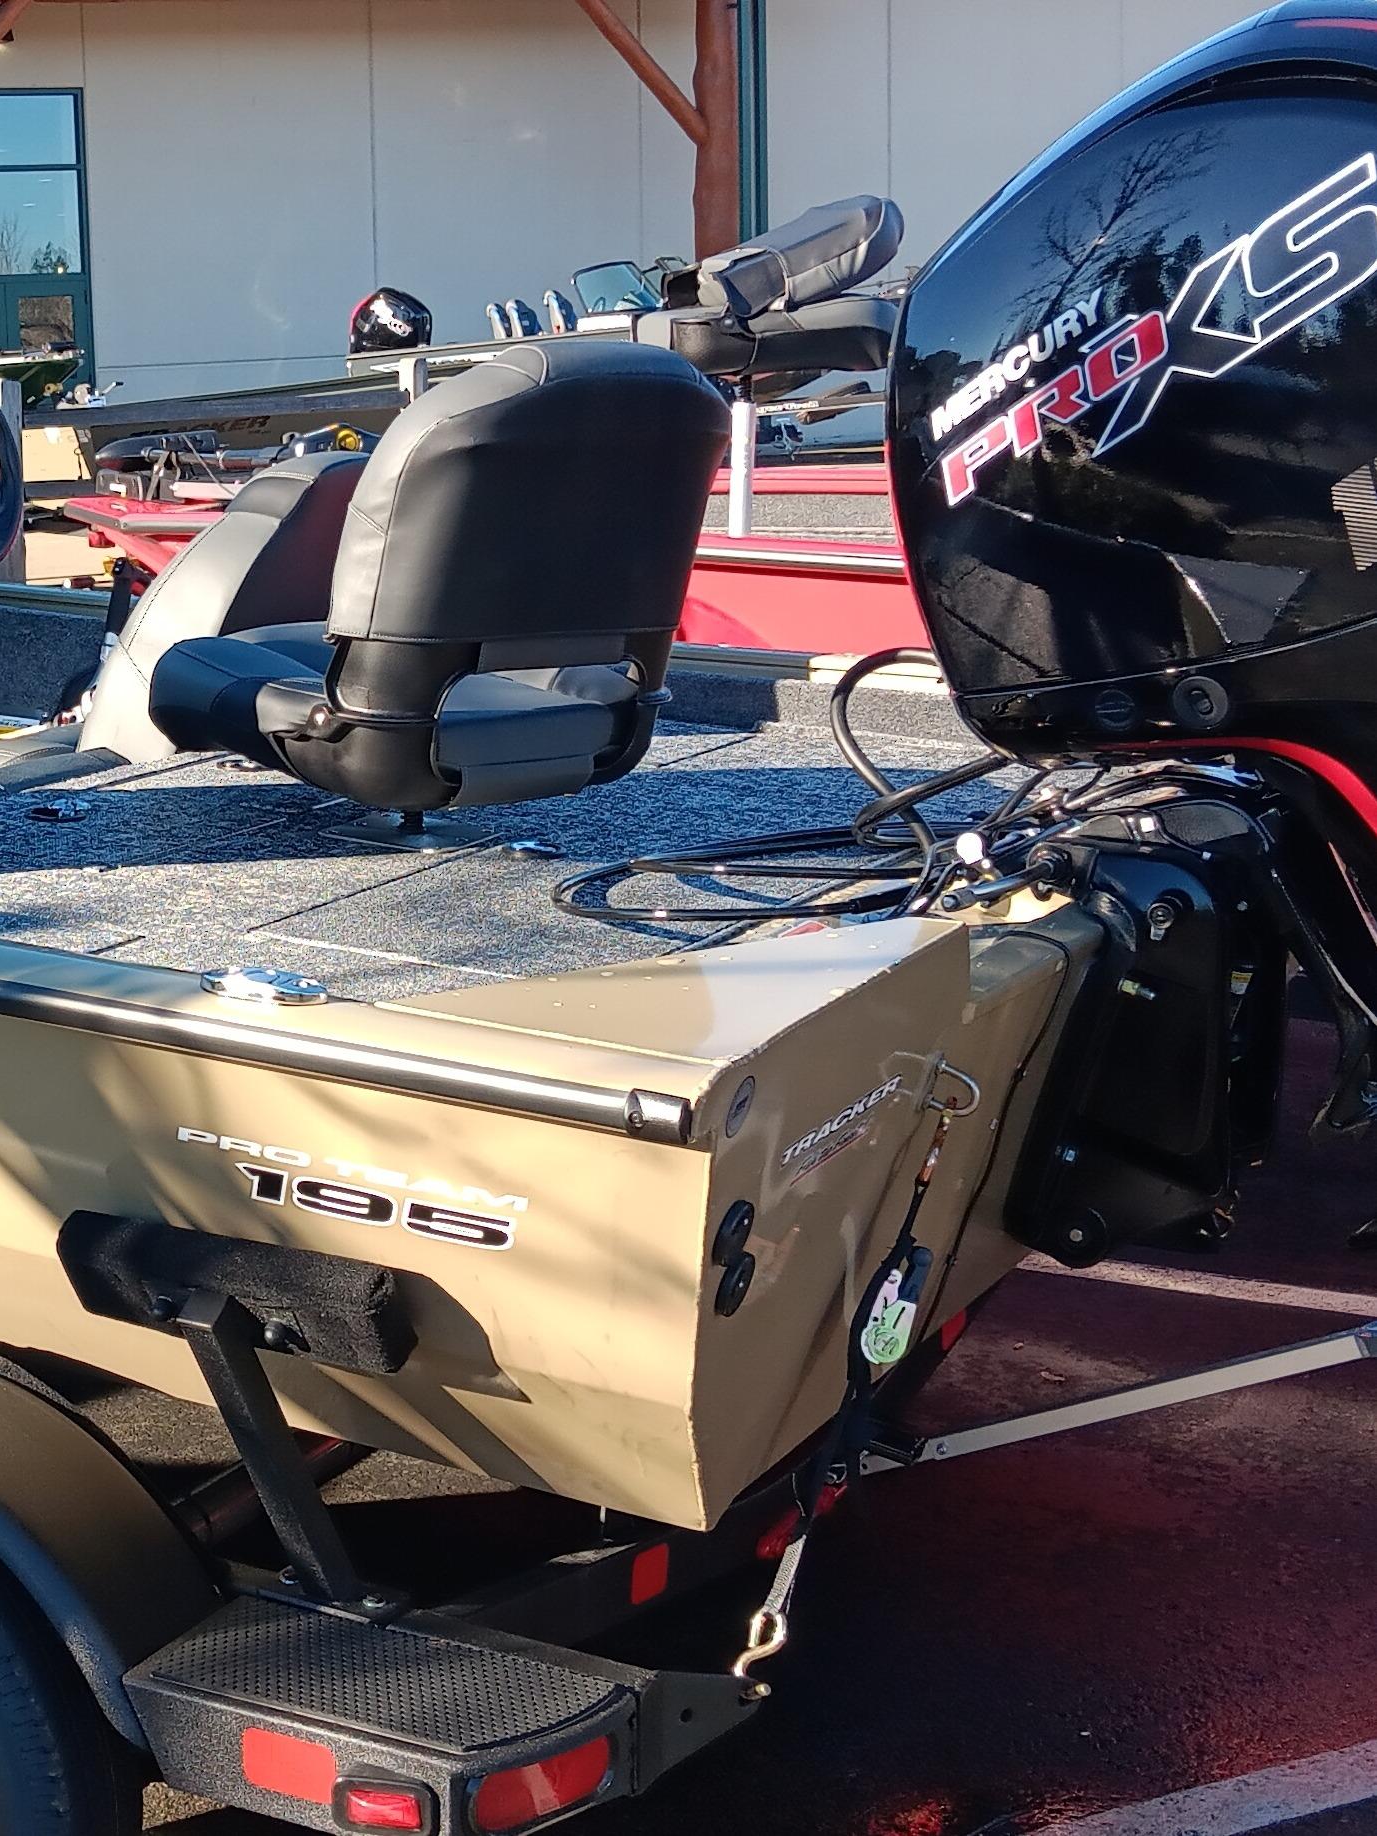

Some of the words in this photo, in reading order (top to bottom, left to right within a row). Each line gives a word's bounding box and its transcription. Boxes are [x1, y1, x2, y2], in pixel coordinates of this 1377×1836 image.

[930, 286, 1104, 441] MERCURY
[941, 310, 1170, 508] PRO
[1077, 151, 1377, 459] XS
[176, 1126, 312, 1168] PRO
[325, 1156, 529, 1212] TEAM
[780, 1073, 904, 1169] TRACKER
[234, 1162, 517, 1251] 195
